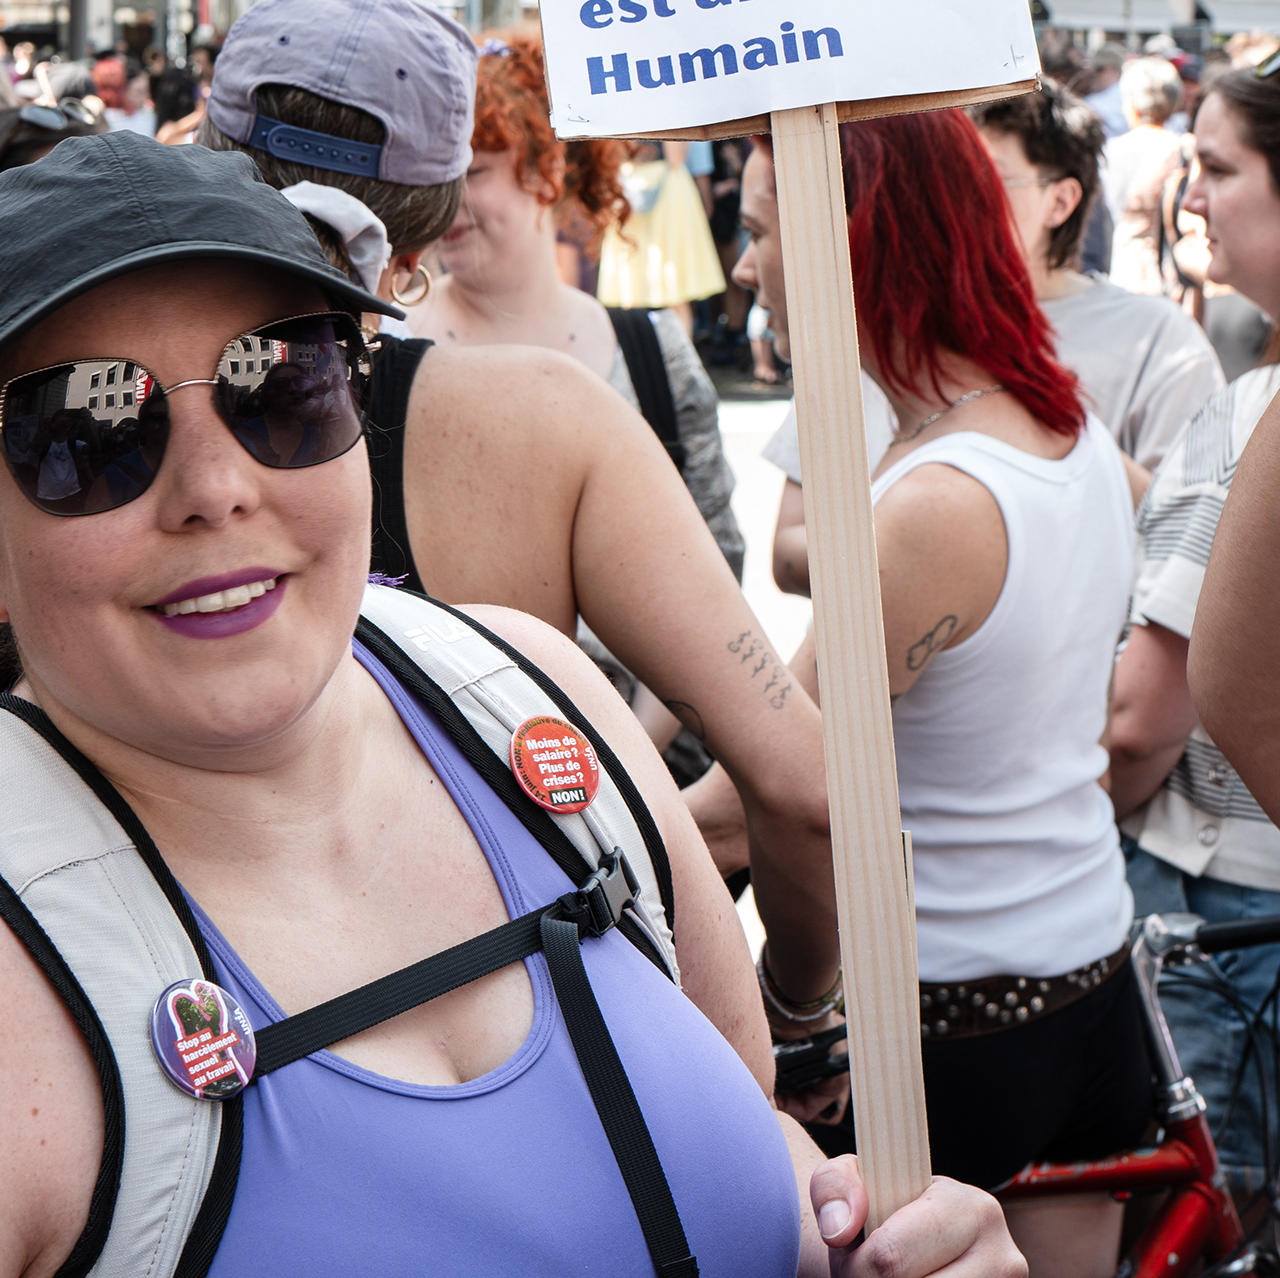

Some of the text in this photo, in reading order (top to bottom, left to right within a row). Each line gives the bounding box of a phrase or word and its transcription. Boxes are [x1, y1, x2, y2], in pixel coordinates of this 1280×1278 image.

[586, 20, 844, 96] Humain
[526, 736, 577, 750] Moins de
[514, 748, 524, 769] NON
[539, 760, 581, 774] Plus de
[543, 772, 584, 787] crises?
[552, 789, 585, 803] NON!
[176, 1031, 213, 1052] Stop au
[182, 1032, 238, 1064] harcèlement
[188, 1054, 219, 1075] sexuel
[193, 1059, 236, 1087] au travail
